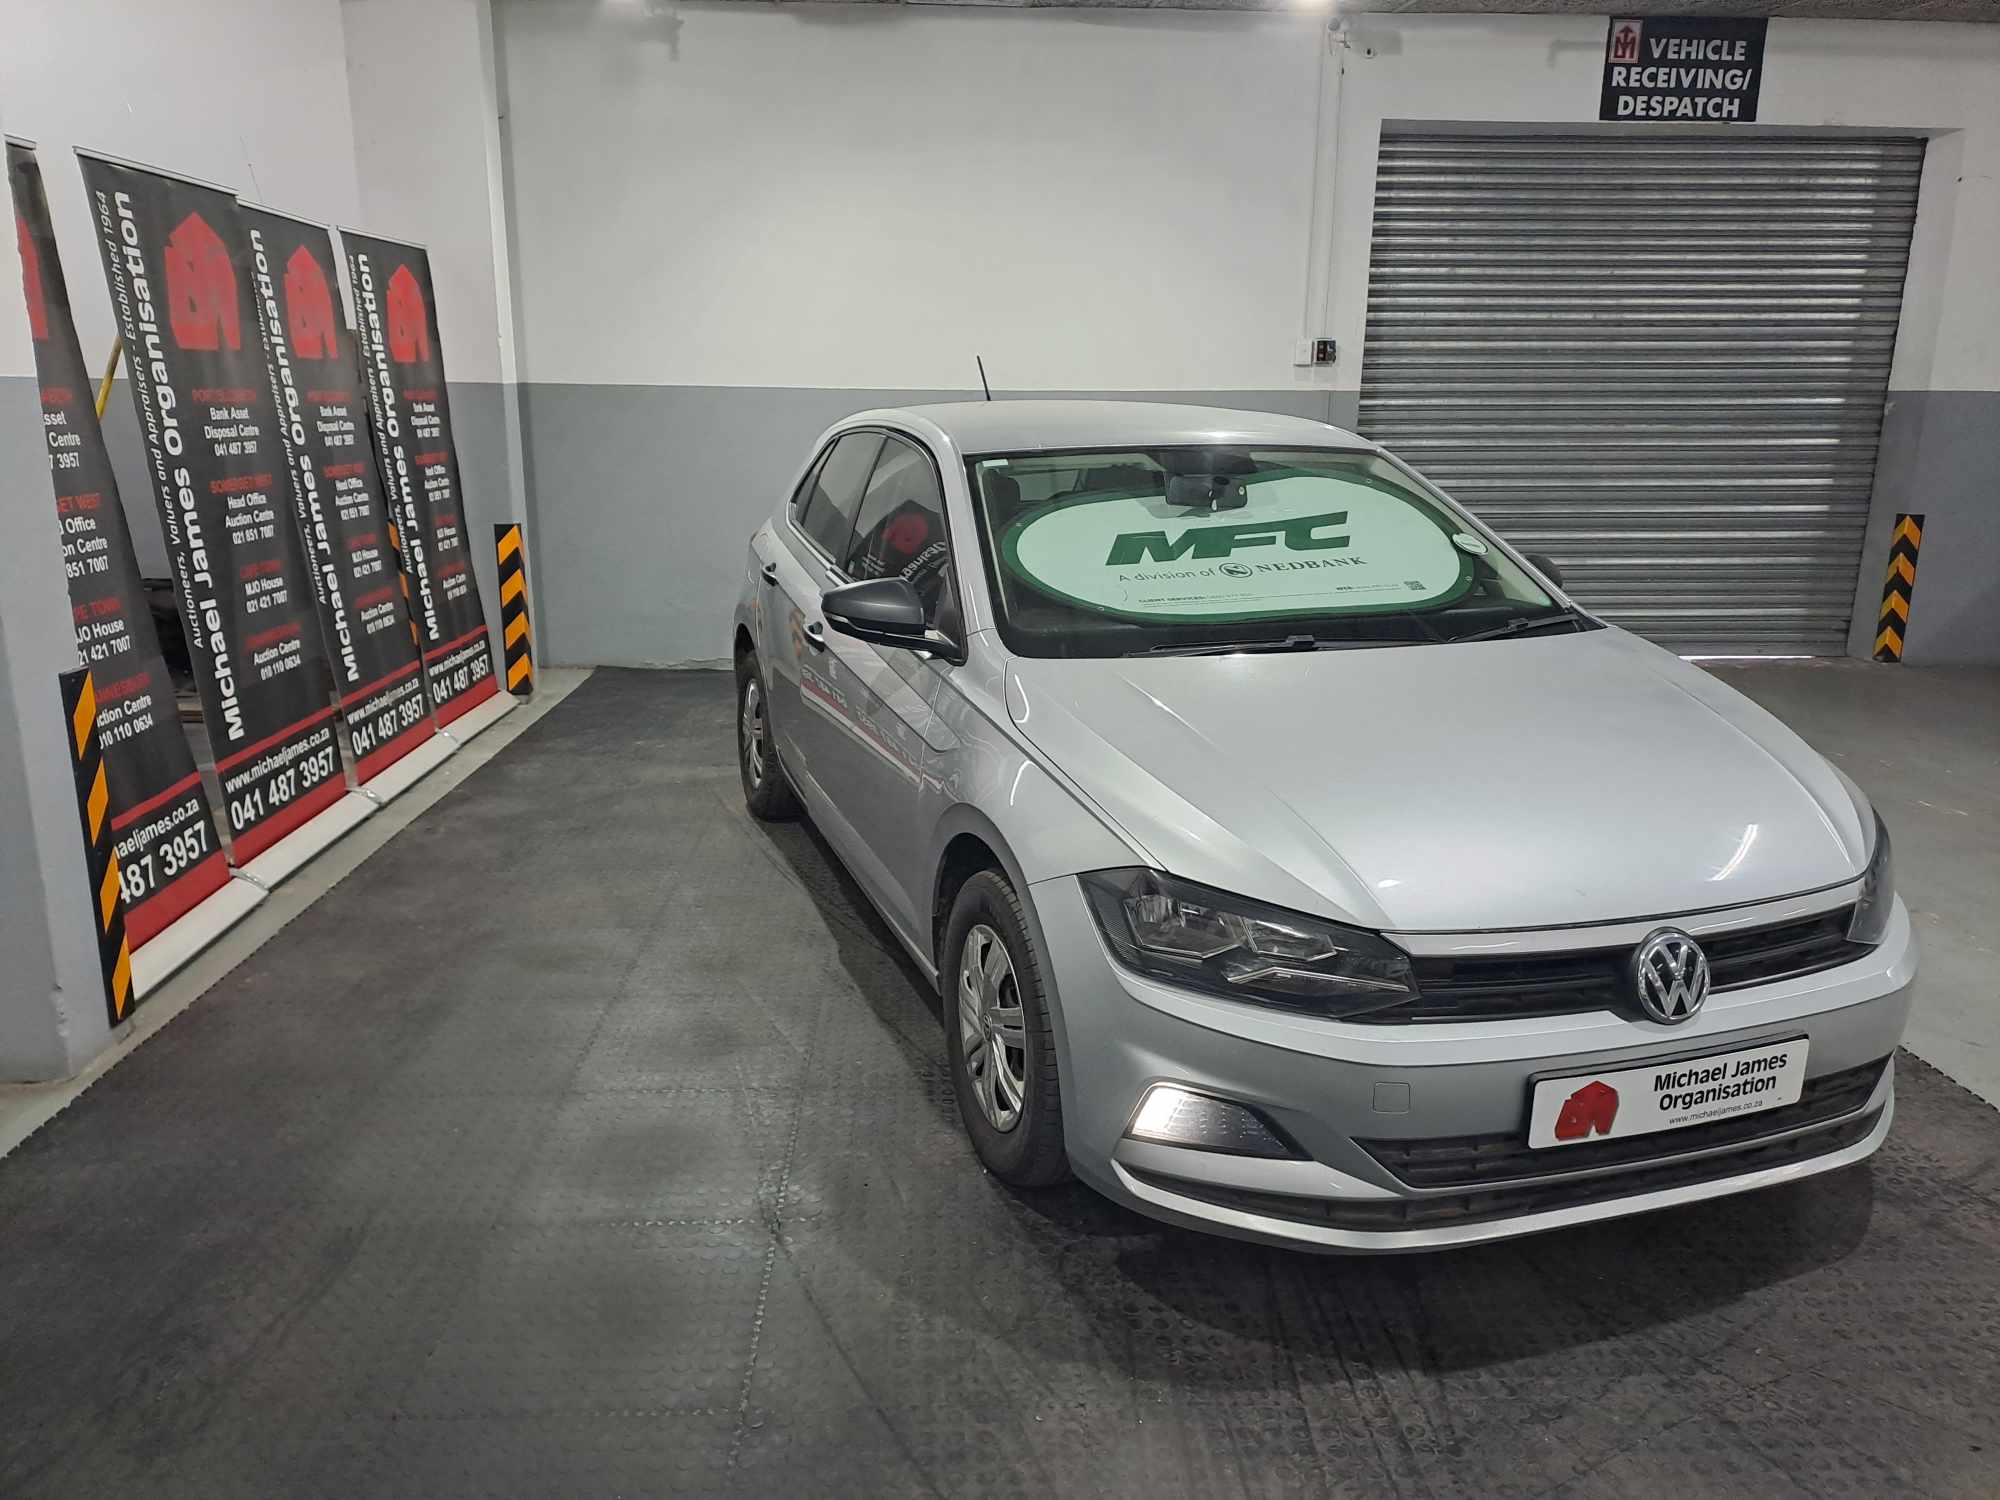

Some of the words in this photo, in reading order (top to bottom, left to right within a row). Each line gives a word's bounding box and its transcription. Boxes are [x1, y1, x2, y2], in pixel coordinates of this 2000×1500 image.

[1650, 38, 1747, 61] VEHICLE
[1612, 66, 1752, 91] RECEIVING/
[1617, 95, 1740, 118] DESPATCH
[95, 190, 113, 237] 1964
[105, 239, 137, 341] Established
[114, 191, 183, 456] Organisation
[250, 229, 306, 446] Organisation
[358, 254, 399, 438] Organisation
[43, 411, 67, 426] sset
[133, 356, 161, 446] Appraisers
[209, 407, 230, 421] Bank
[48, 431, 81, 448] Centre
[204, 425, 238, 441] Disposal
[56, 452, 80, 469] 3957
[151, 448, 167, 480] and
[281, 438, 295, 466] and
[299, 454, 331, 555] James
[393, 445, 418, 532] James
[65, 516, 96, 534] Office
[161, 484, 181, 546] Valuers
[174, 466, 212, 588] James
[225, 512, 252, 529] Auction
[76, 536, 108, 554] Centre
[1105, 511, 1350, 566] MFC
[66, 561, 86, 579] 851
[88, 556, 109, 574] 7007
[1119, 574, 1130, 582] A
[1135, 568, 1196, 581] division
[1202, 566, 1215, 578] of
[1256, 557, 1367, 574] NEDBANK
[410, 538, 440, 640] Michael
[76, 625, 91, 643] JO
[91, 619, 125, 638] House
[321, 564, 359, 682] Michael
[78, 649, 89, 666] 21
[90, 642, 109, 660] 421
[110, 635, 131, 656] 7007
[253, 647, 279, 665] Auction
[200, 598, 245, 741] Michael
[432, 676, 452, 704] 041
[453, 667, 468, 691] 487
[470, 654, 490, 680] 3957
[123, 694, 152, 715] Centre
[113, 722, 132, 742] 110
[133, 713, 153, 733] 0634
[352, 723, 376, 756] 041
[378, 709, 398, 739] 487
[399, 693, 424, 727] 3957
[225, 727, 330, 794] www.michaeljames.co.za
[231, 788, 264, 830] 041
[269, 768, 296, 806] 487
[300, 746, 334, 788] 3957
[159, 820, 208, 876] 3957
[1653, 1063, 1728, 1092] Michael
[1731, 1053, 1788, 1078] James
[1659, 1075, 1777, 1111] Organisation
